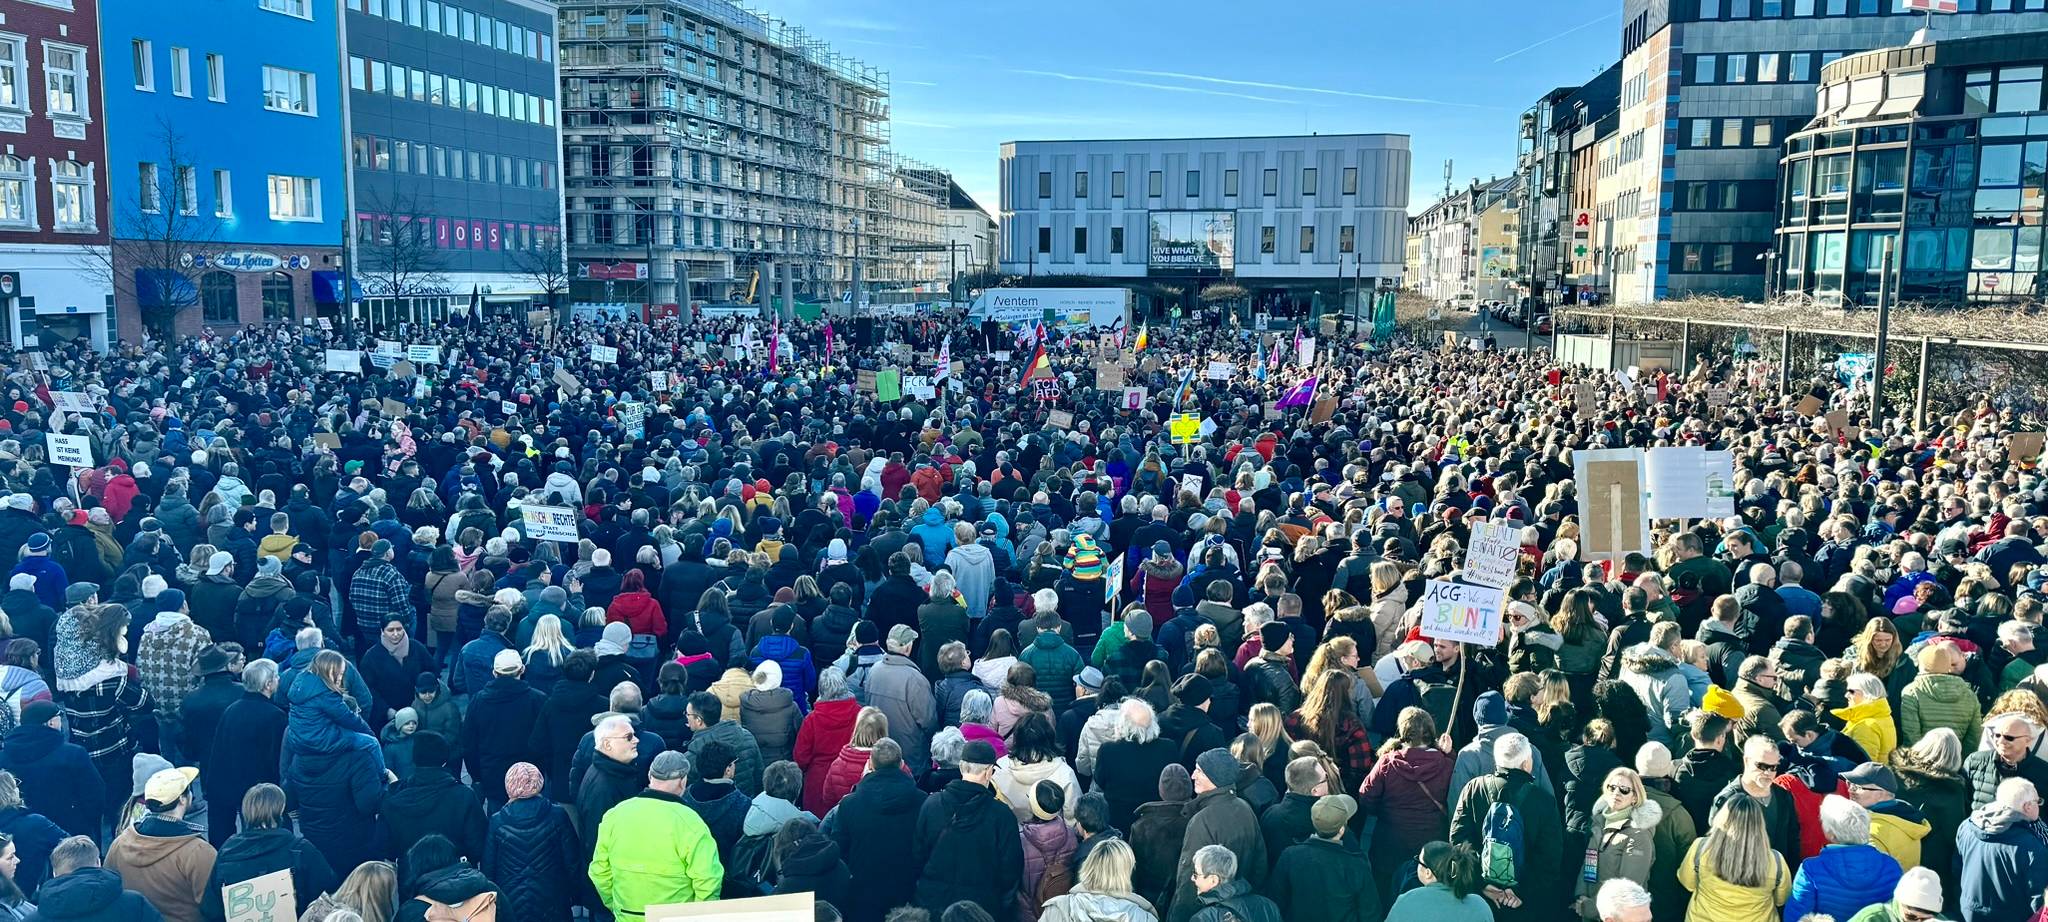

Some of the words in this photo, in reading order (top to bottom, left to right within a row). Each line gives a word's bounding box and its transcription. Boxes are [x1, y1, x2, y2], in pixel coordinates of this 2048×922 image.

[440, 224, 497, 243] JOBS
[904, 376, 925, 386] FCK
[1035, 378, 1060, 390] FCK
[1035, 388, 1060, 398] AFD
[55, 437, 69, 445] HASS
[57, 455, 82, 463] MEINUNG!
[1434, 602, 1495, 630] BUNT
